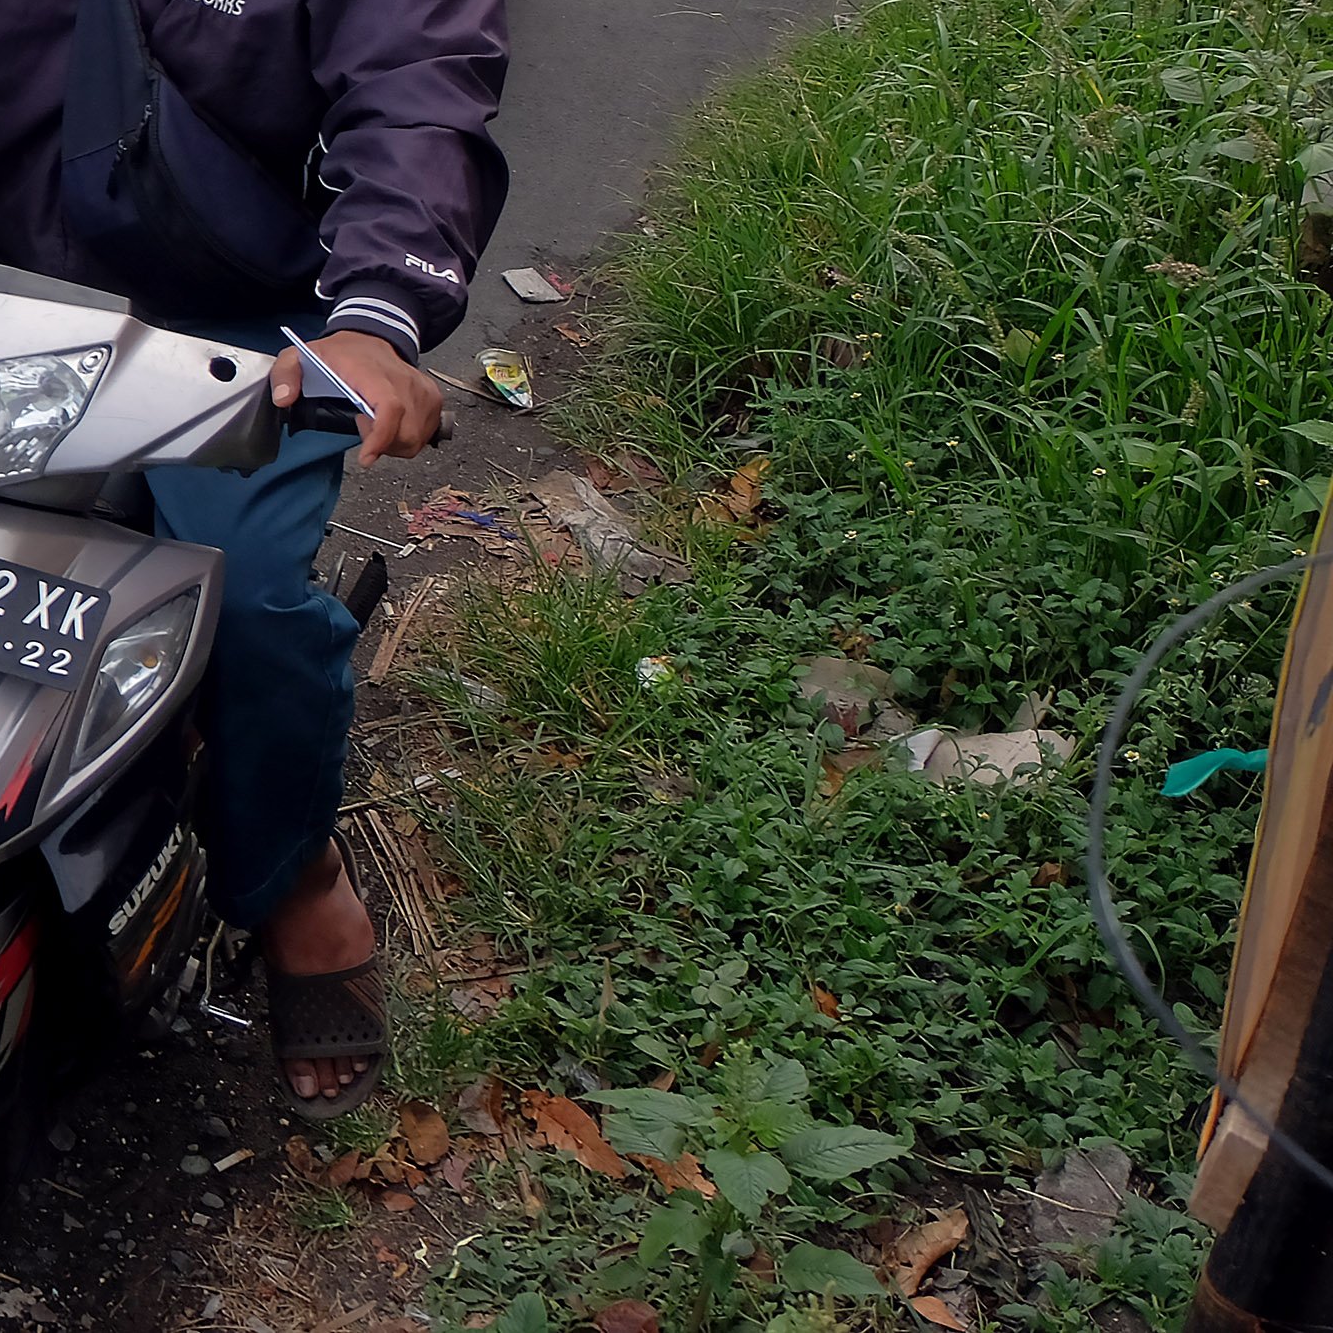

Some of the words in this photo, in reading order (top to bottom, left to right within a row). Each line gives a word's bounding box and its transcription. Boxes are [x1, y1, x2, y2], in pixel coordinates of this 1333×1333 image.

[405, 253, 460, 284] FILA
[21, 580, 100, 641] XK
[108, 823, 184, 936] SUZUKI
